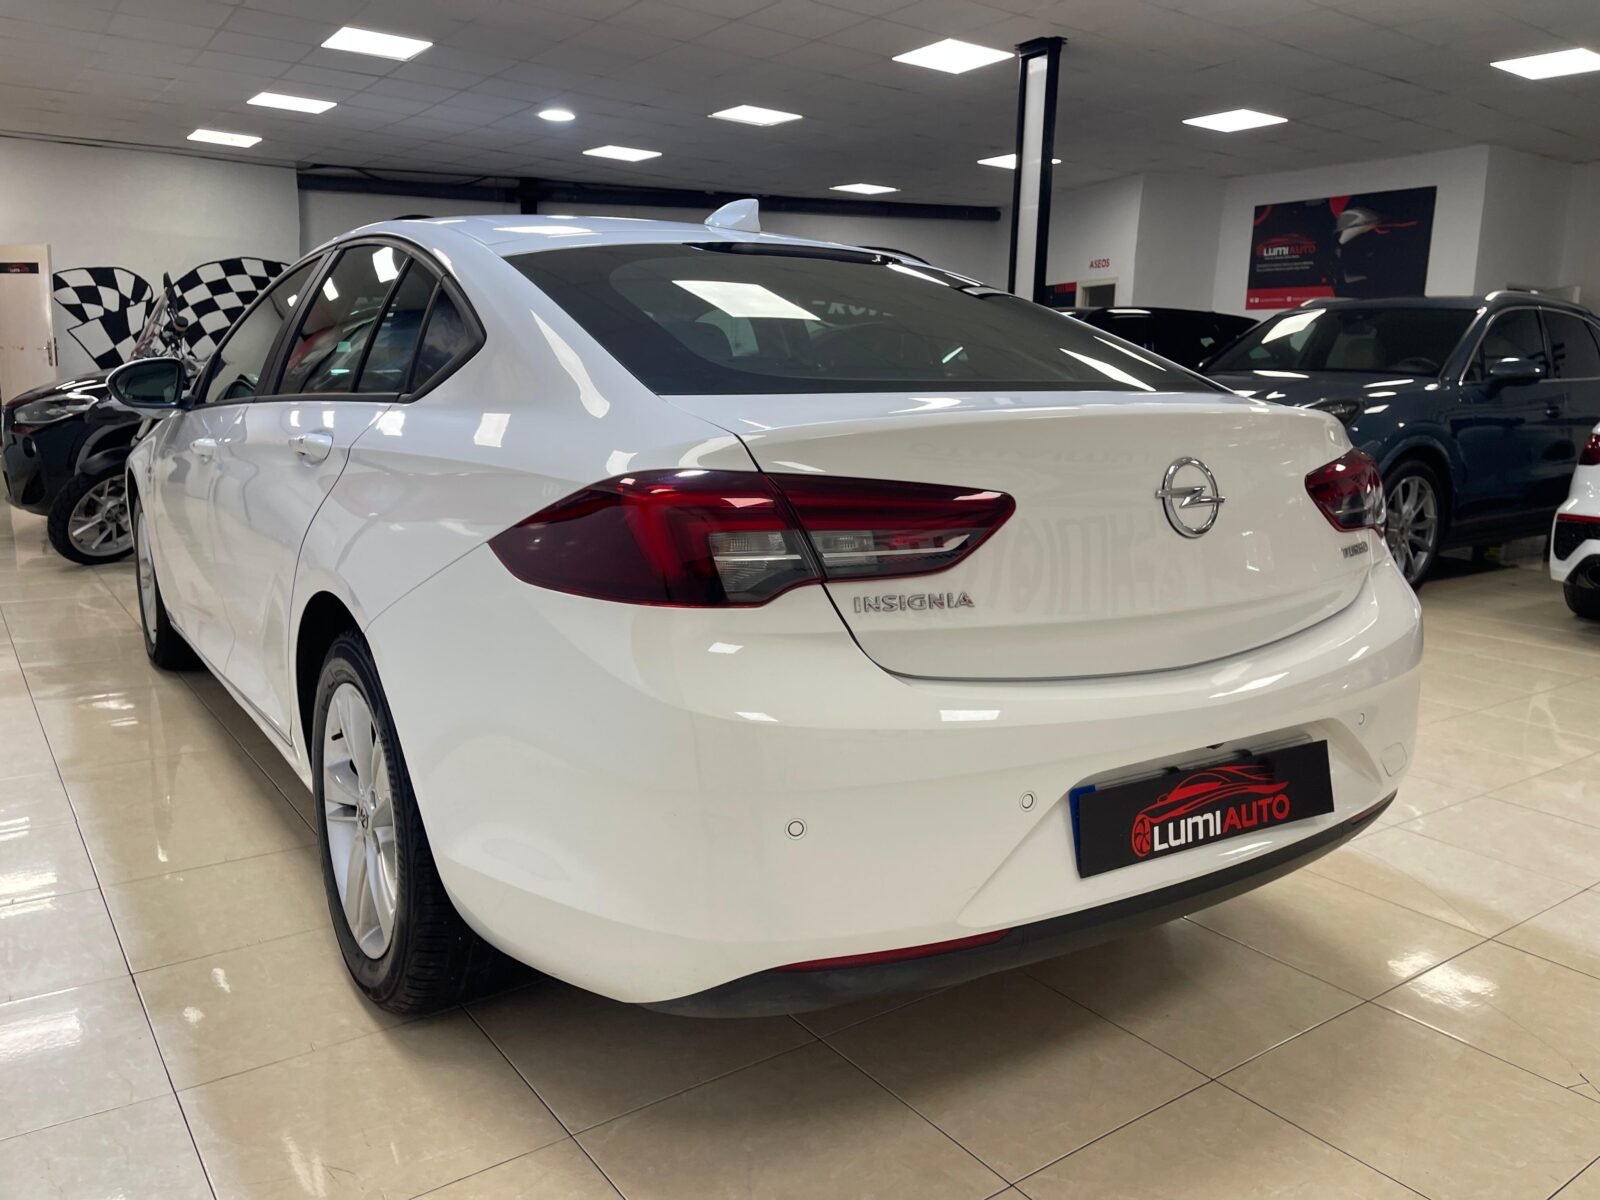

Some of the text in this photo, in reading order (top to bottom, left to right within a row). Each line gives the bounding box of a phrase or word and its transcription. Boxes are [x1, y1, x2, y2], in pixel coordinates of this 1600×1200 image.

[1089, 258, 1110, 269] ASEOS
[1341, 541, 1368, 559] TURBO
[853, 592, 975, 613] INSIGNIA
